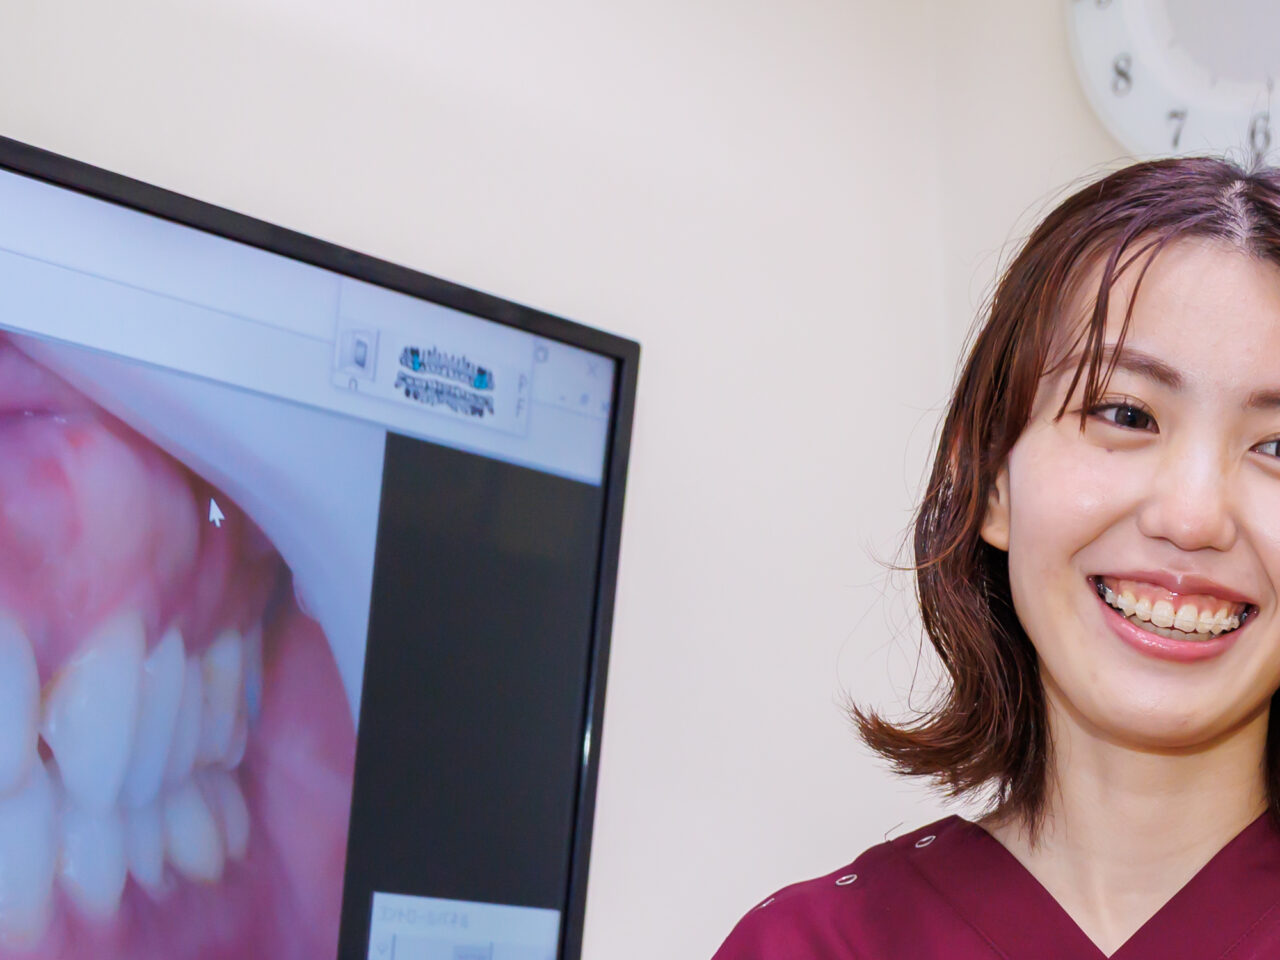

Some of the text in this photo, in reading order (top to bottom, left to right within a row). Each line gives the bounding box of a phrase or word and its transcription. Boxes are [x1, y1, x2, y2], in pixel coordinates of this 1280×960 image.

[1111, 52, 1133, 97] 8
[1166, 107, 1188, 149] 7
[1249, 111, 1271, 153] 6
